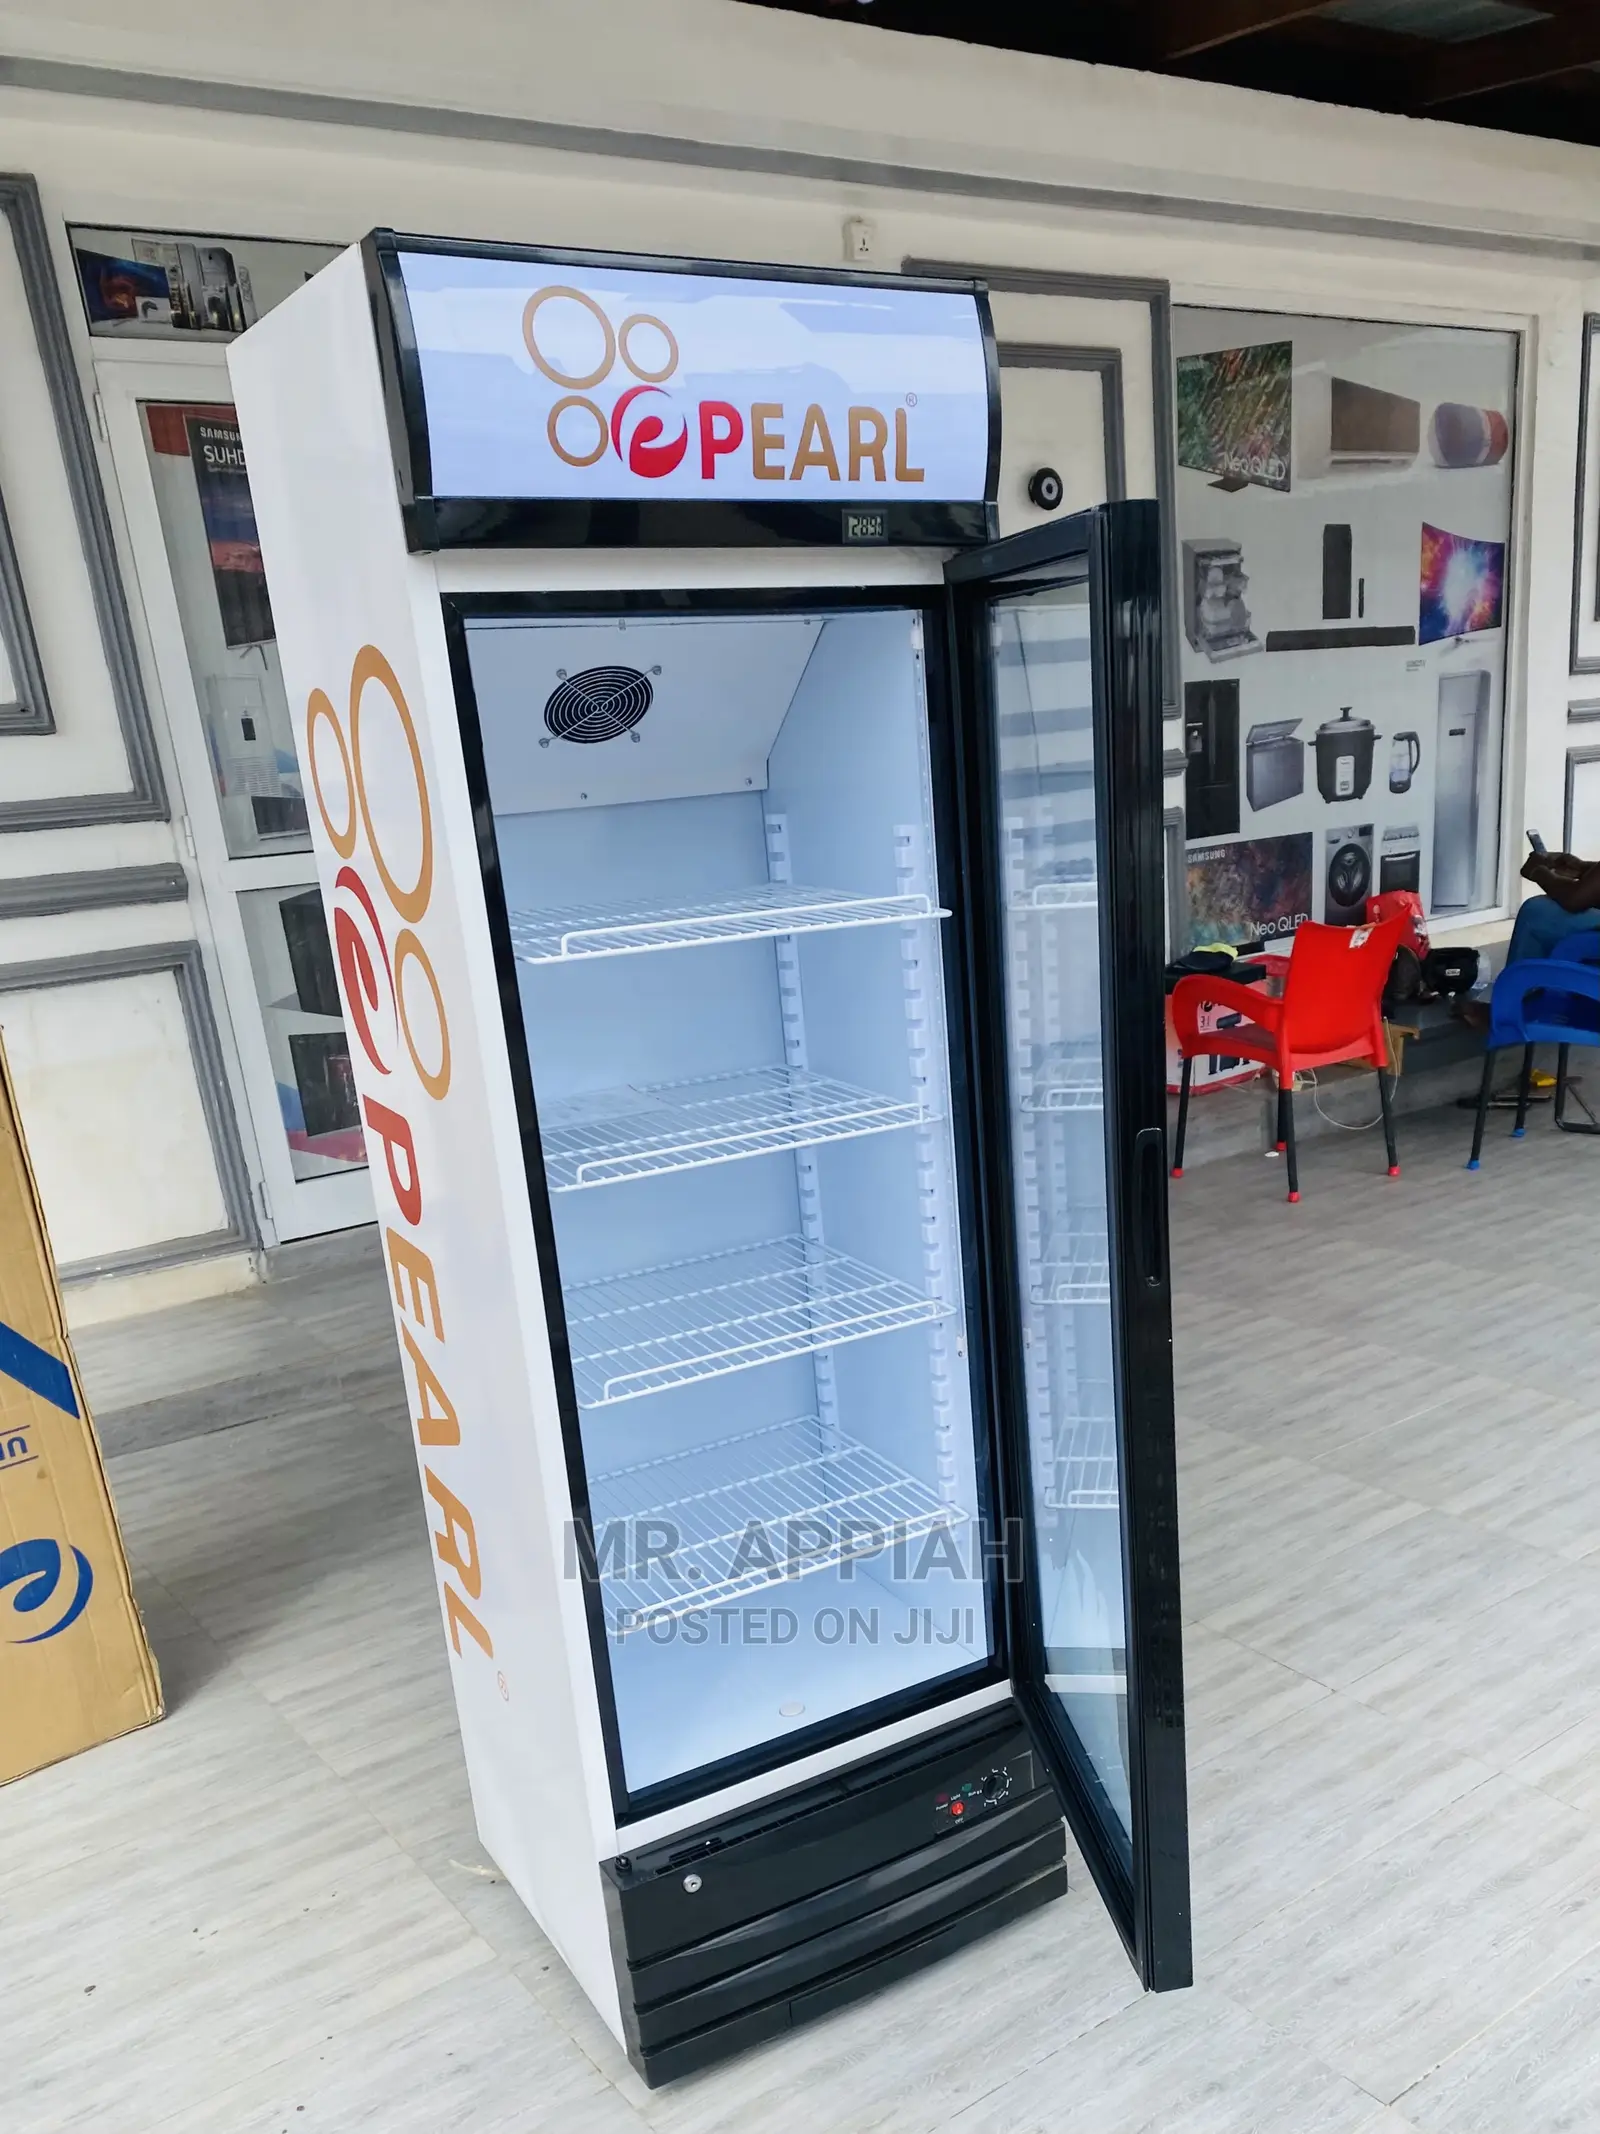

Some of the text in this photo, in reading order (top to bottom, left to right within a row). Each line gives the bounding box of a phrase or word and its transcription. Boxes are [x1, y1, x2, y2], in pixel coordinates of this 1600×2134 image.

[700, 400, 925, 482] PEARL
[1187, 849, 1226, 864] SAMSUNG
[1250, 920, 1276, 937] Neo
[361, 1093, 495, 1659] PEARL
